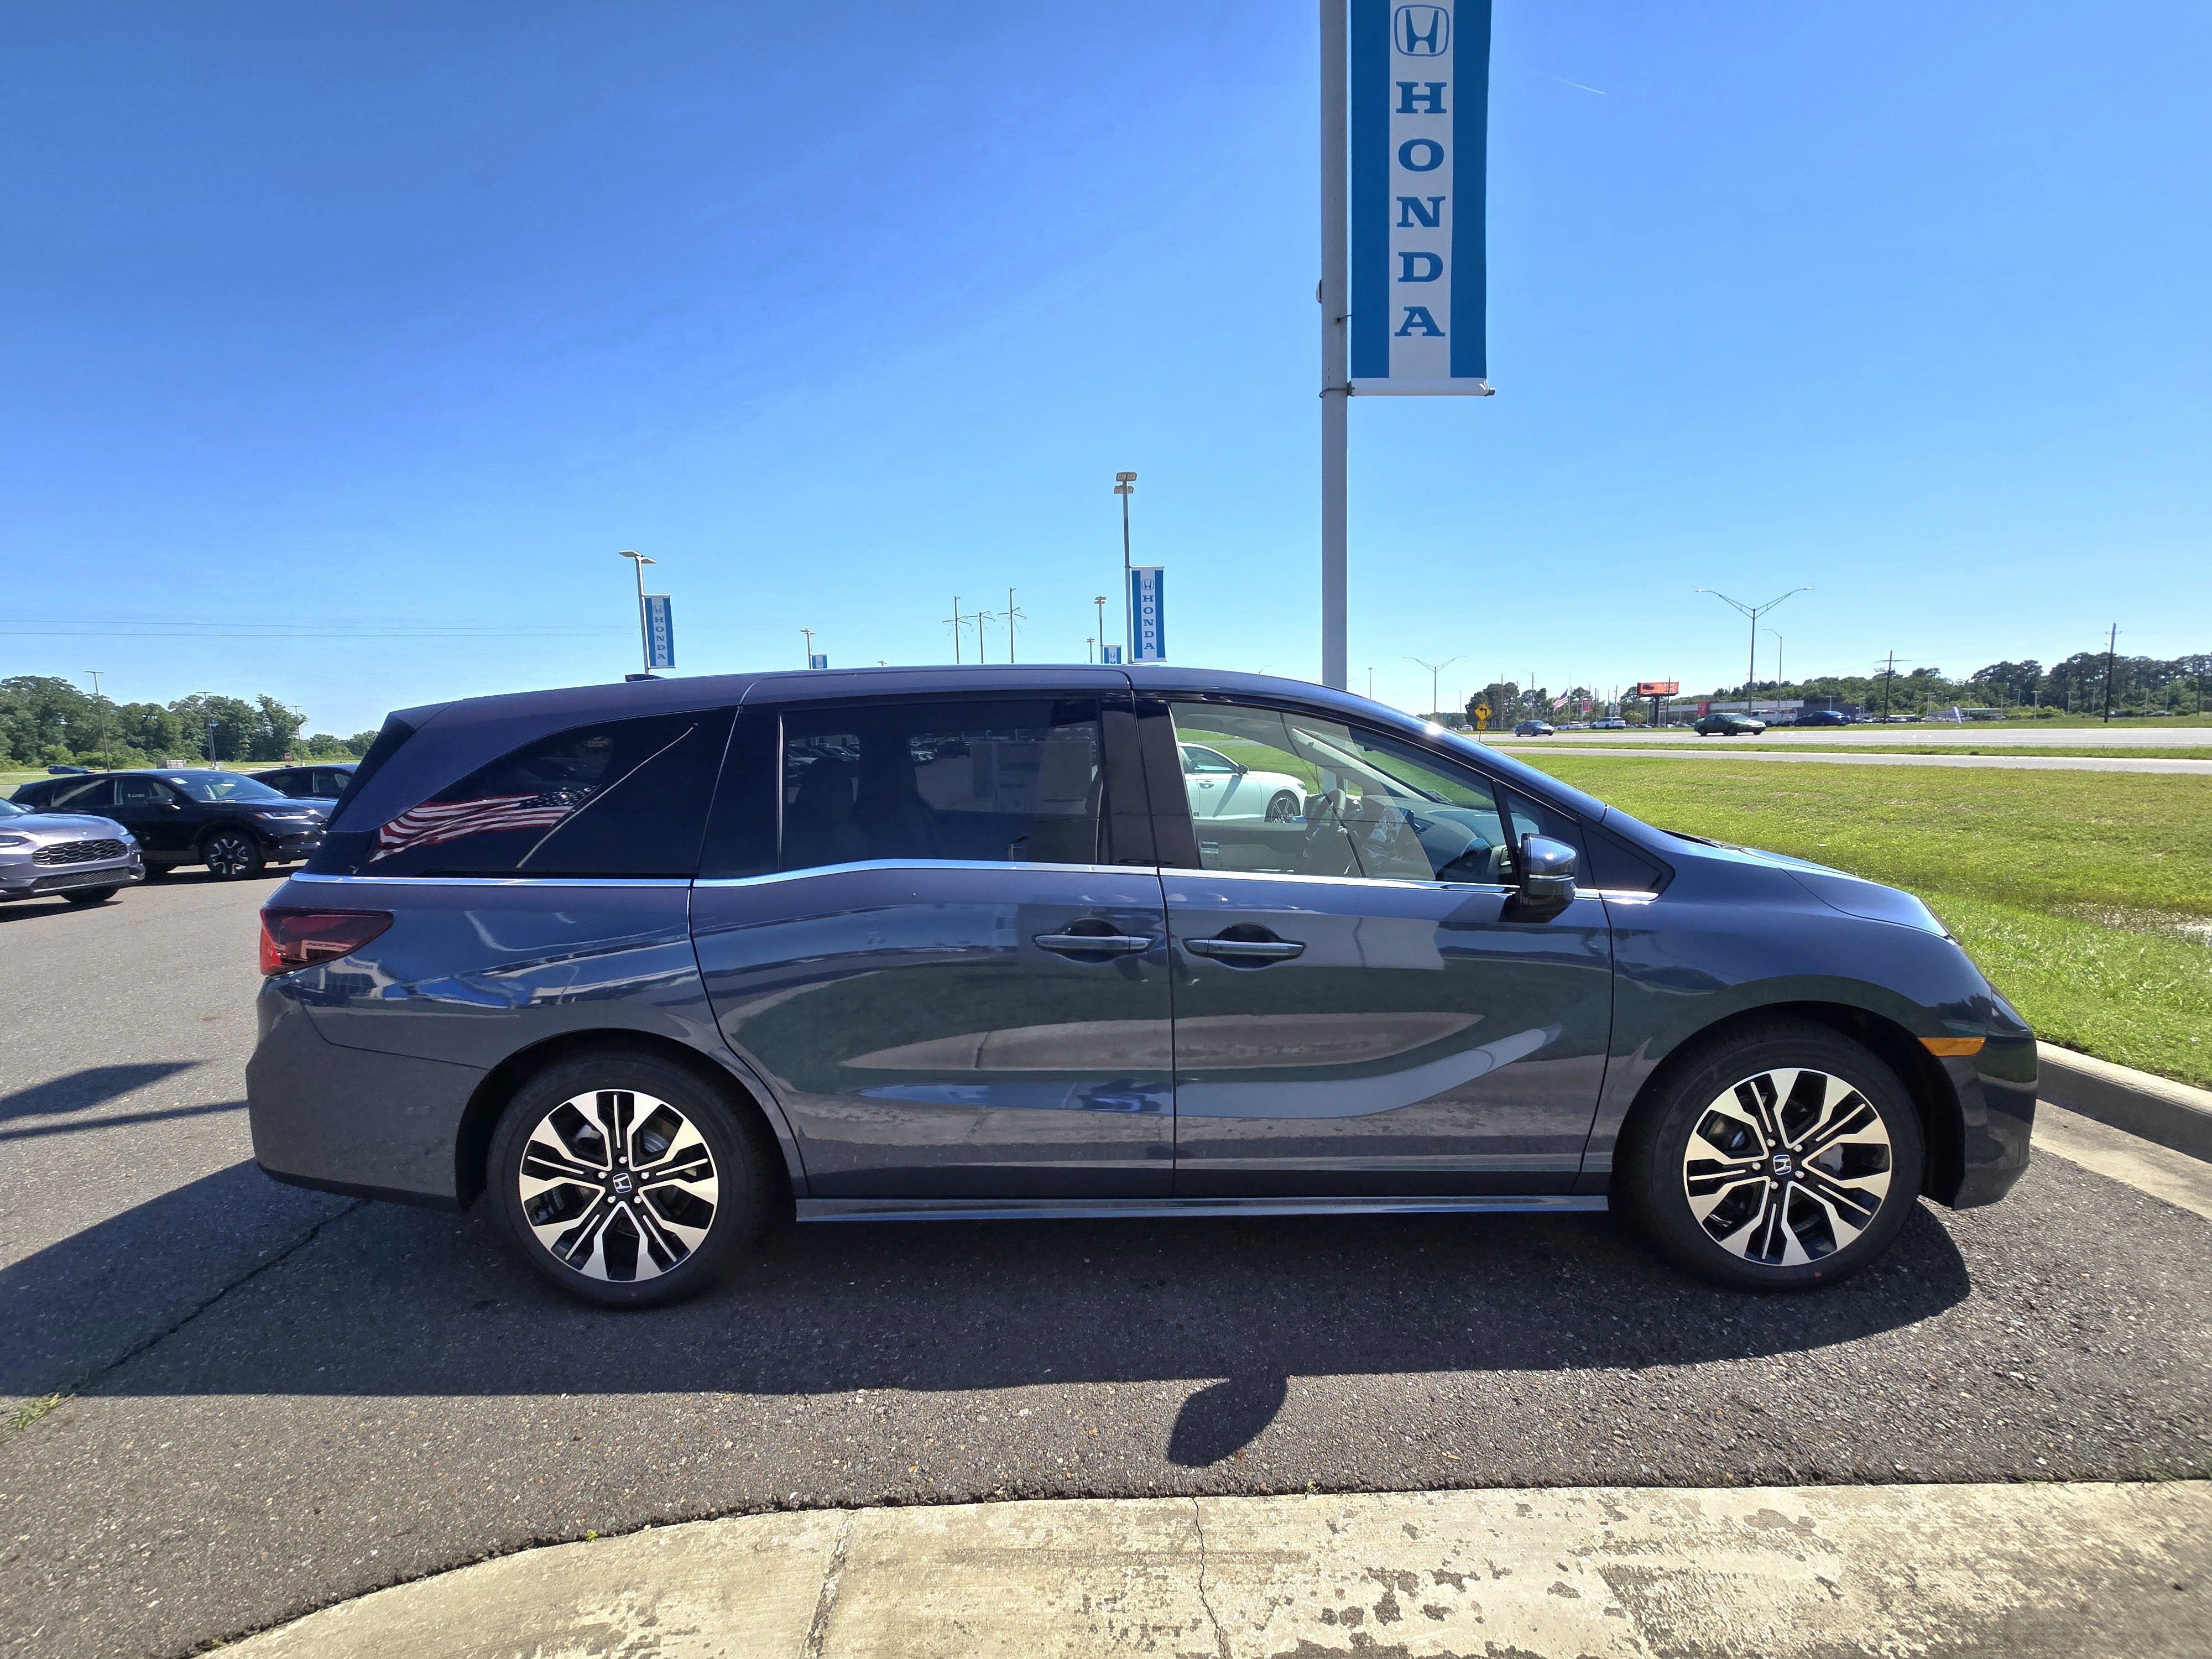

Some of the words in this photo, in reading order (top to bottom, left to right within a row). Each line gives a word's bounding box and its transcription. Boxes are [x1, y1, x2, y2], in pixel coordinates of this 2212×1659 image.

[1394, 81, 1447, 337] HONDA
[654, 617, 666, 660] HONDA
[1142, 594, 1155, 650] HONDA
